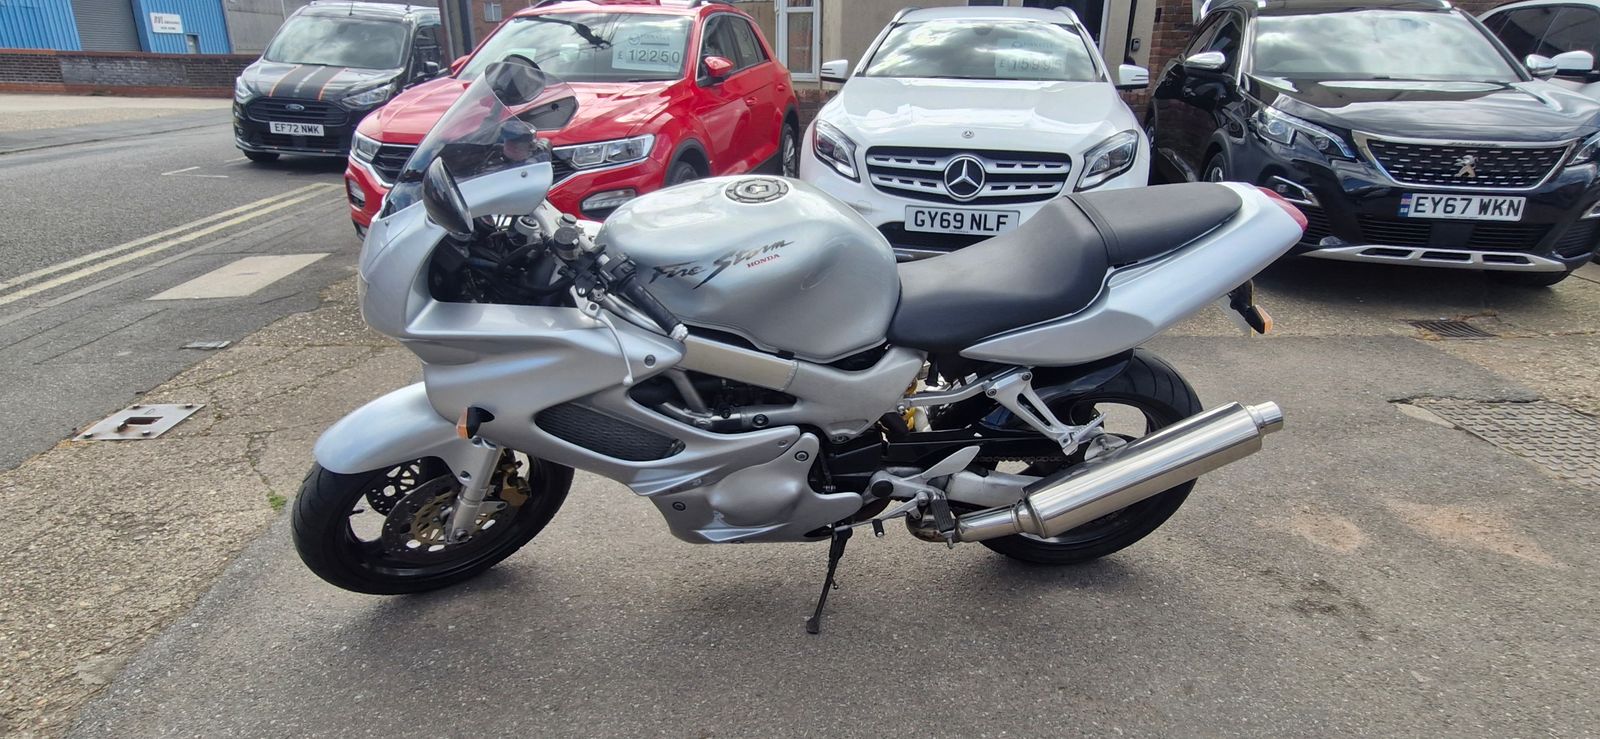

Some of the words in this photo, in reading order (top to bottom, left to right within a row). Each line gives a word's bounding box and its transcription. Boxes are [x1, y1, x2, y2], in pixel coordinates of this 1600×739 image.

[628, 49, 680, 64] 12250
[274, 122, 300, 133] EF72
[1413, 196, 1473, 215] EY67
[1478, 198, 1522, 217] WKN
[914, 209, 965, 230] GY69
[970, 212, 1009, 232] NLF
[692, 239, 795, 290] Storm
[746, 252, 780, 268] HONDA
